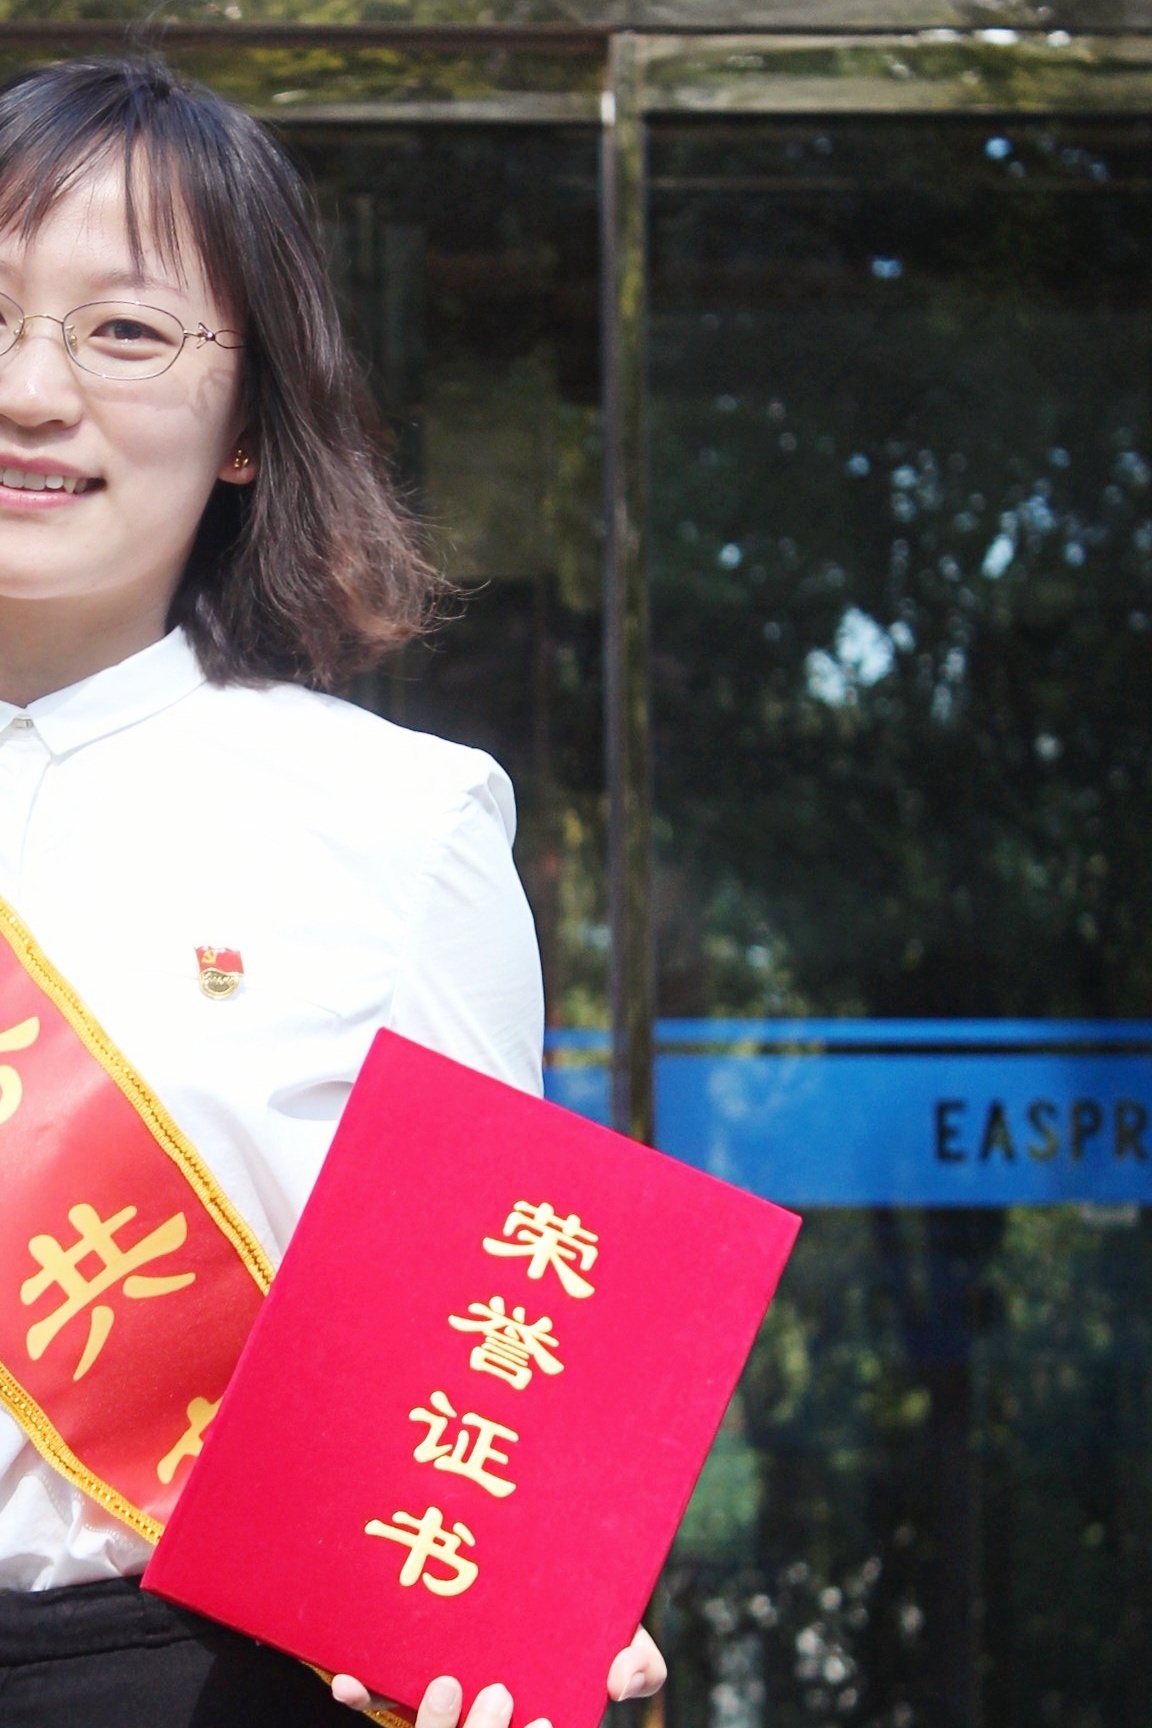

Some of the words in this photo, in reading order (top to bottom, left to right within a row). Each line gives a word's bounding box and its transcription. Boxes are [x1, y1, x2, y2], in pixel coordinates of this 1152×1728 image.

[934, 1099, 1150, 1162] EASPR
[364, 1200, 599, 1597] 荣誉证书
